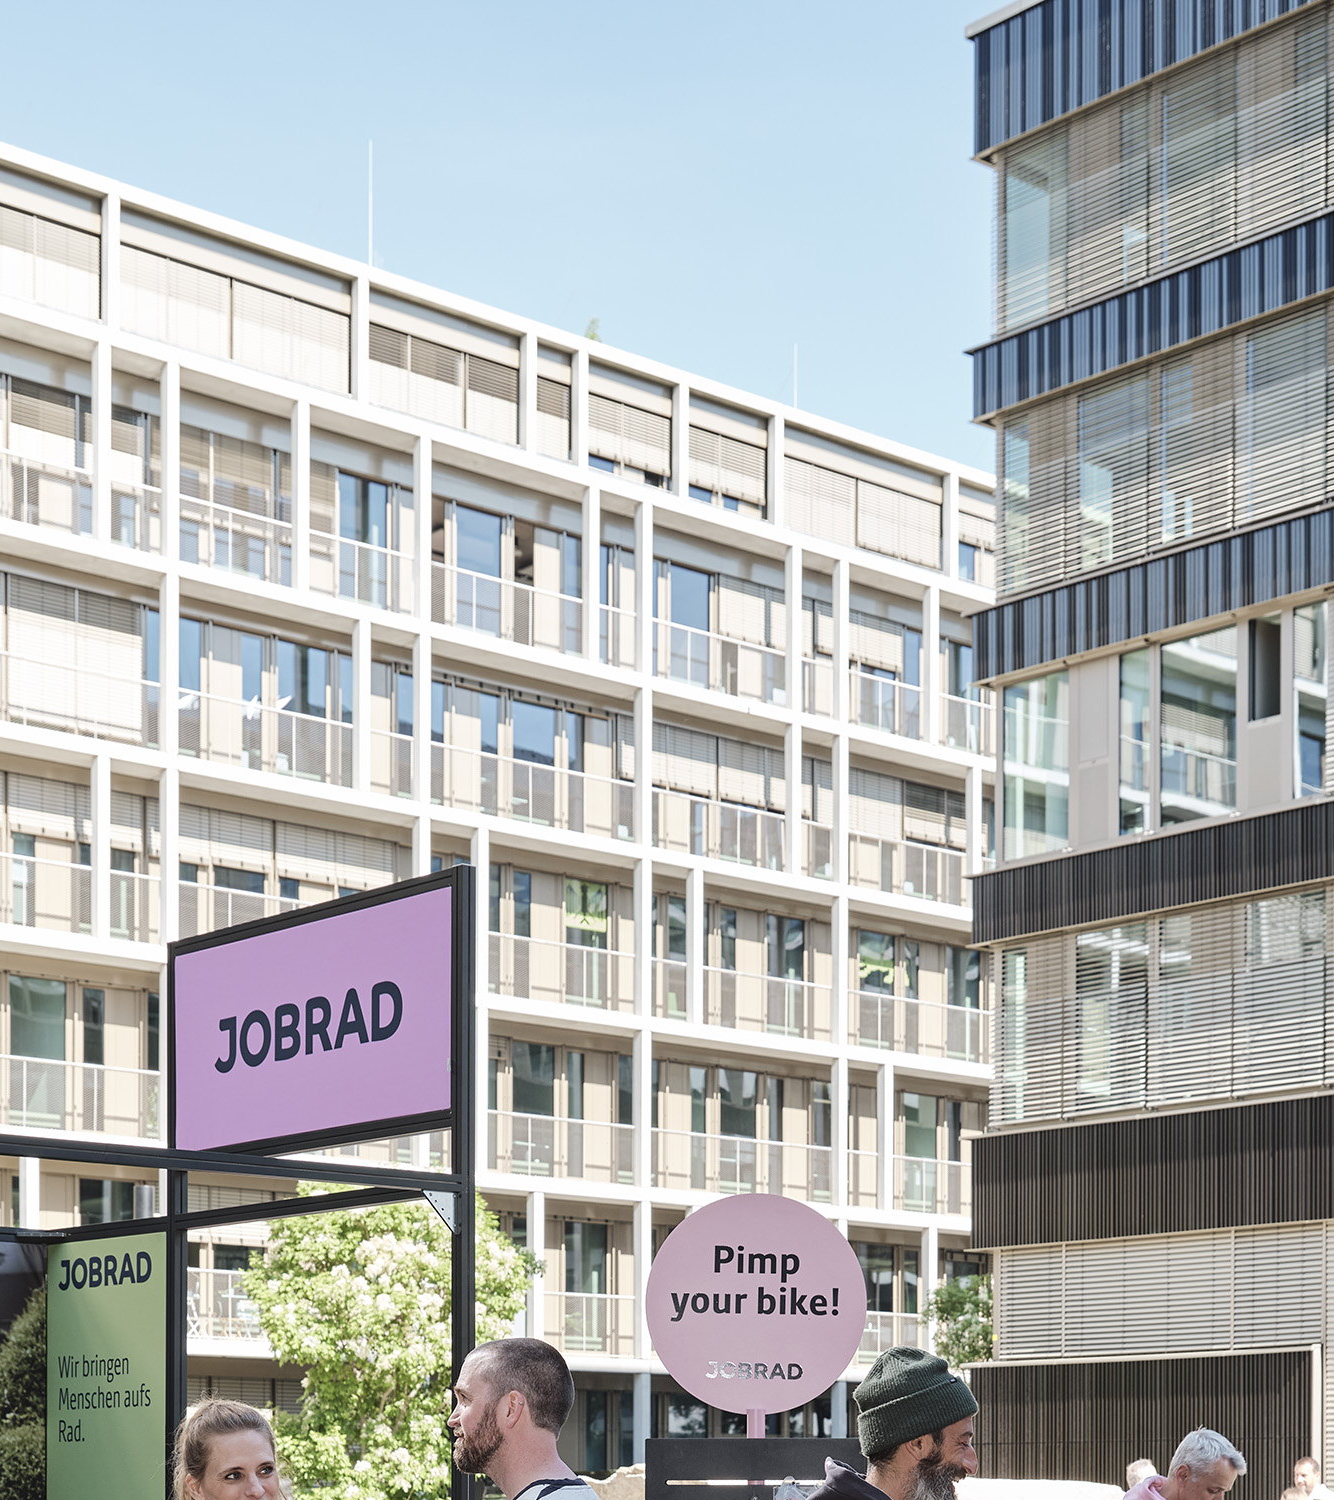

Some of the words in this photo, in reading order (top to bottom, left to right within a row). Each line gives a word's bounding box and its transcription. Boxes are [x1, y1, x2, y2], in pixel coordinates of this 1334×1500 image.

[215, 981, 402, 1073] JOBRAD
[58, 1251, 152, 1291] JOBRAD
[714, 1245, 800, 1283] Pimp
[670, 1292, 748, 1322] your
[757, 1286, 839, 1316] bike!
[58, 1355, 80, 1379] Wir
[82, 1354, 129, 1383] bringen
[705, 1361, 804, 1380] JOBRAD
[58, 1385, 121, 1411] Menschen
[123, 1383, 151, 1408] aufs
[58, 1418, 85, 1443] Rad.
